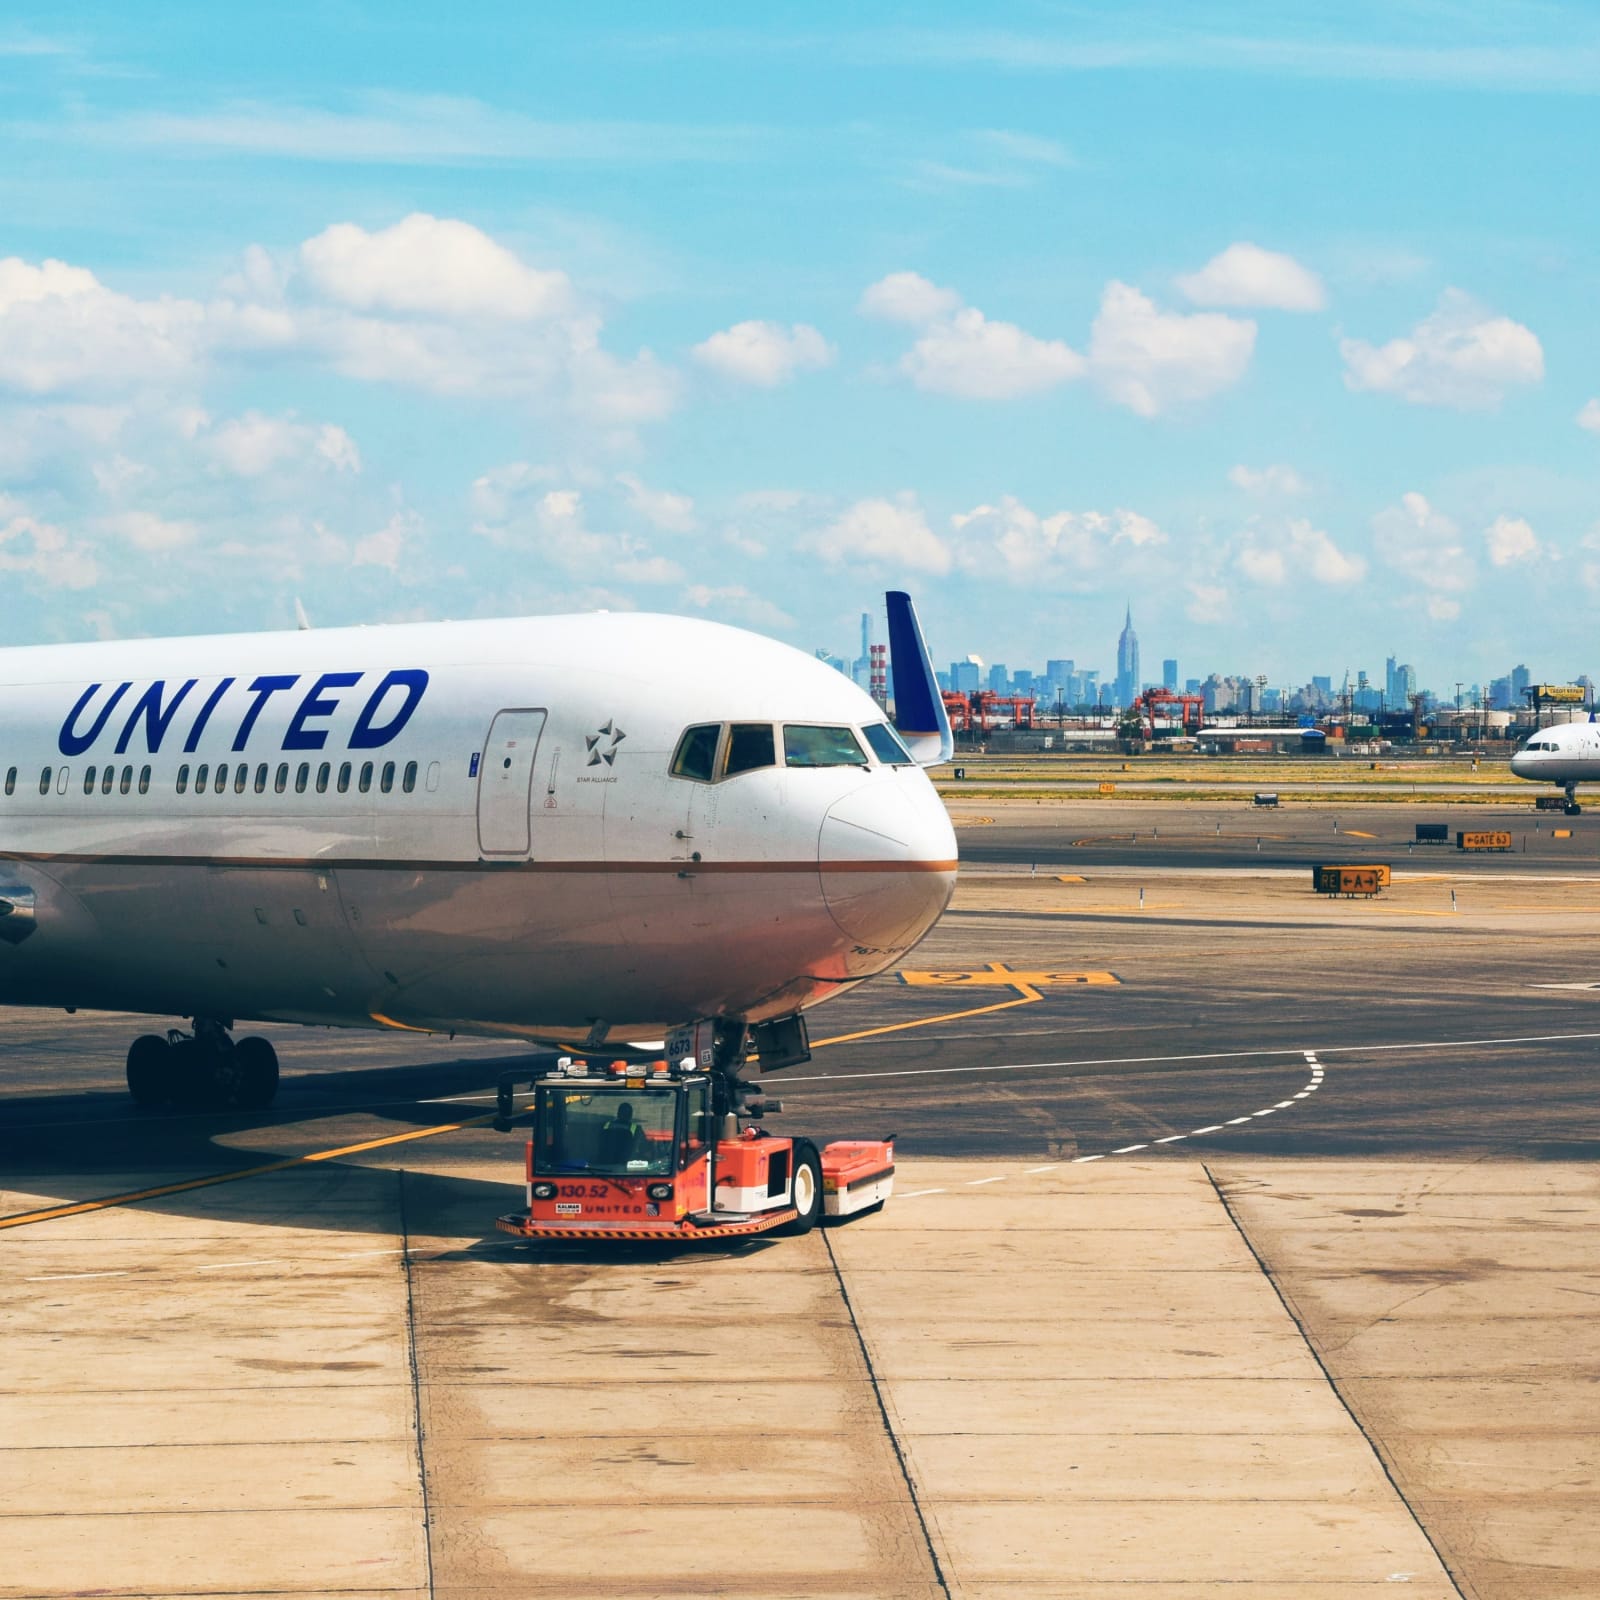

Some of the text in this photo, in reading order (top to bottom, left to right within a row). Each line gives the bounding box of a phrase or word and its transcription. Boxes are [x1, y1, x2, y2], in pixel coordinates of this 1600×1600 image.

[58, 669, 430, 757] UNITED
[1473, 835, 1507, 845] GATE 63
[1354, 874, 1363, 888] A
[669, 1039, 691, 1056] 6673
[560, 1185, 609, 1198] 130.52
[584, 1206, 643, 1214] UNITED
